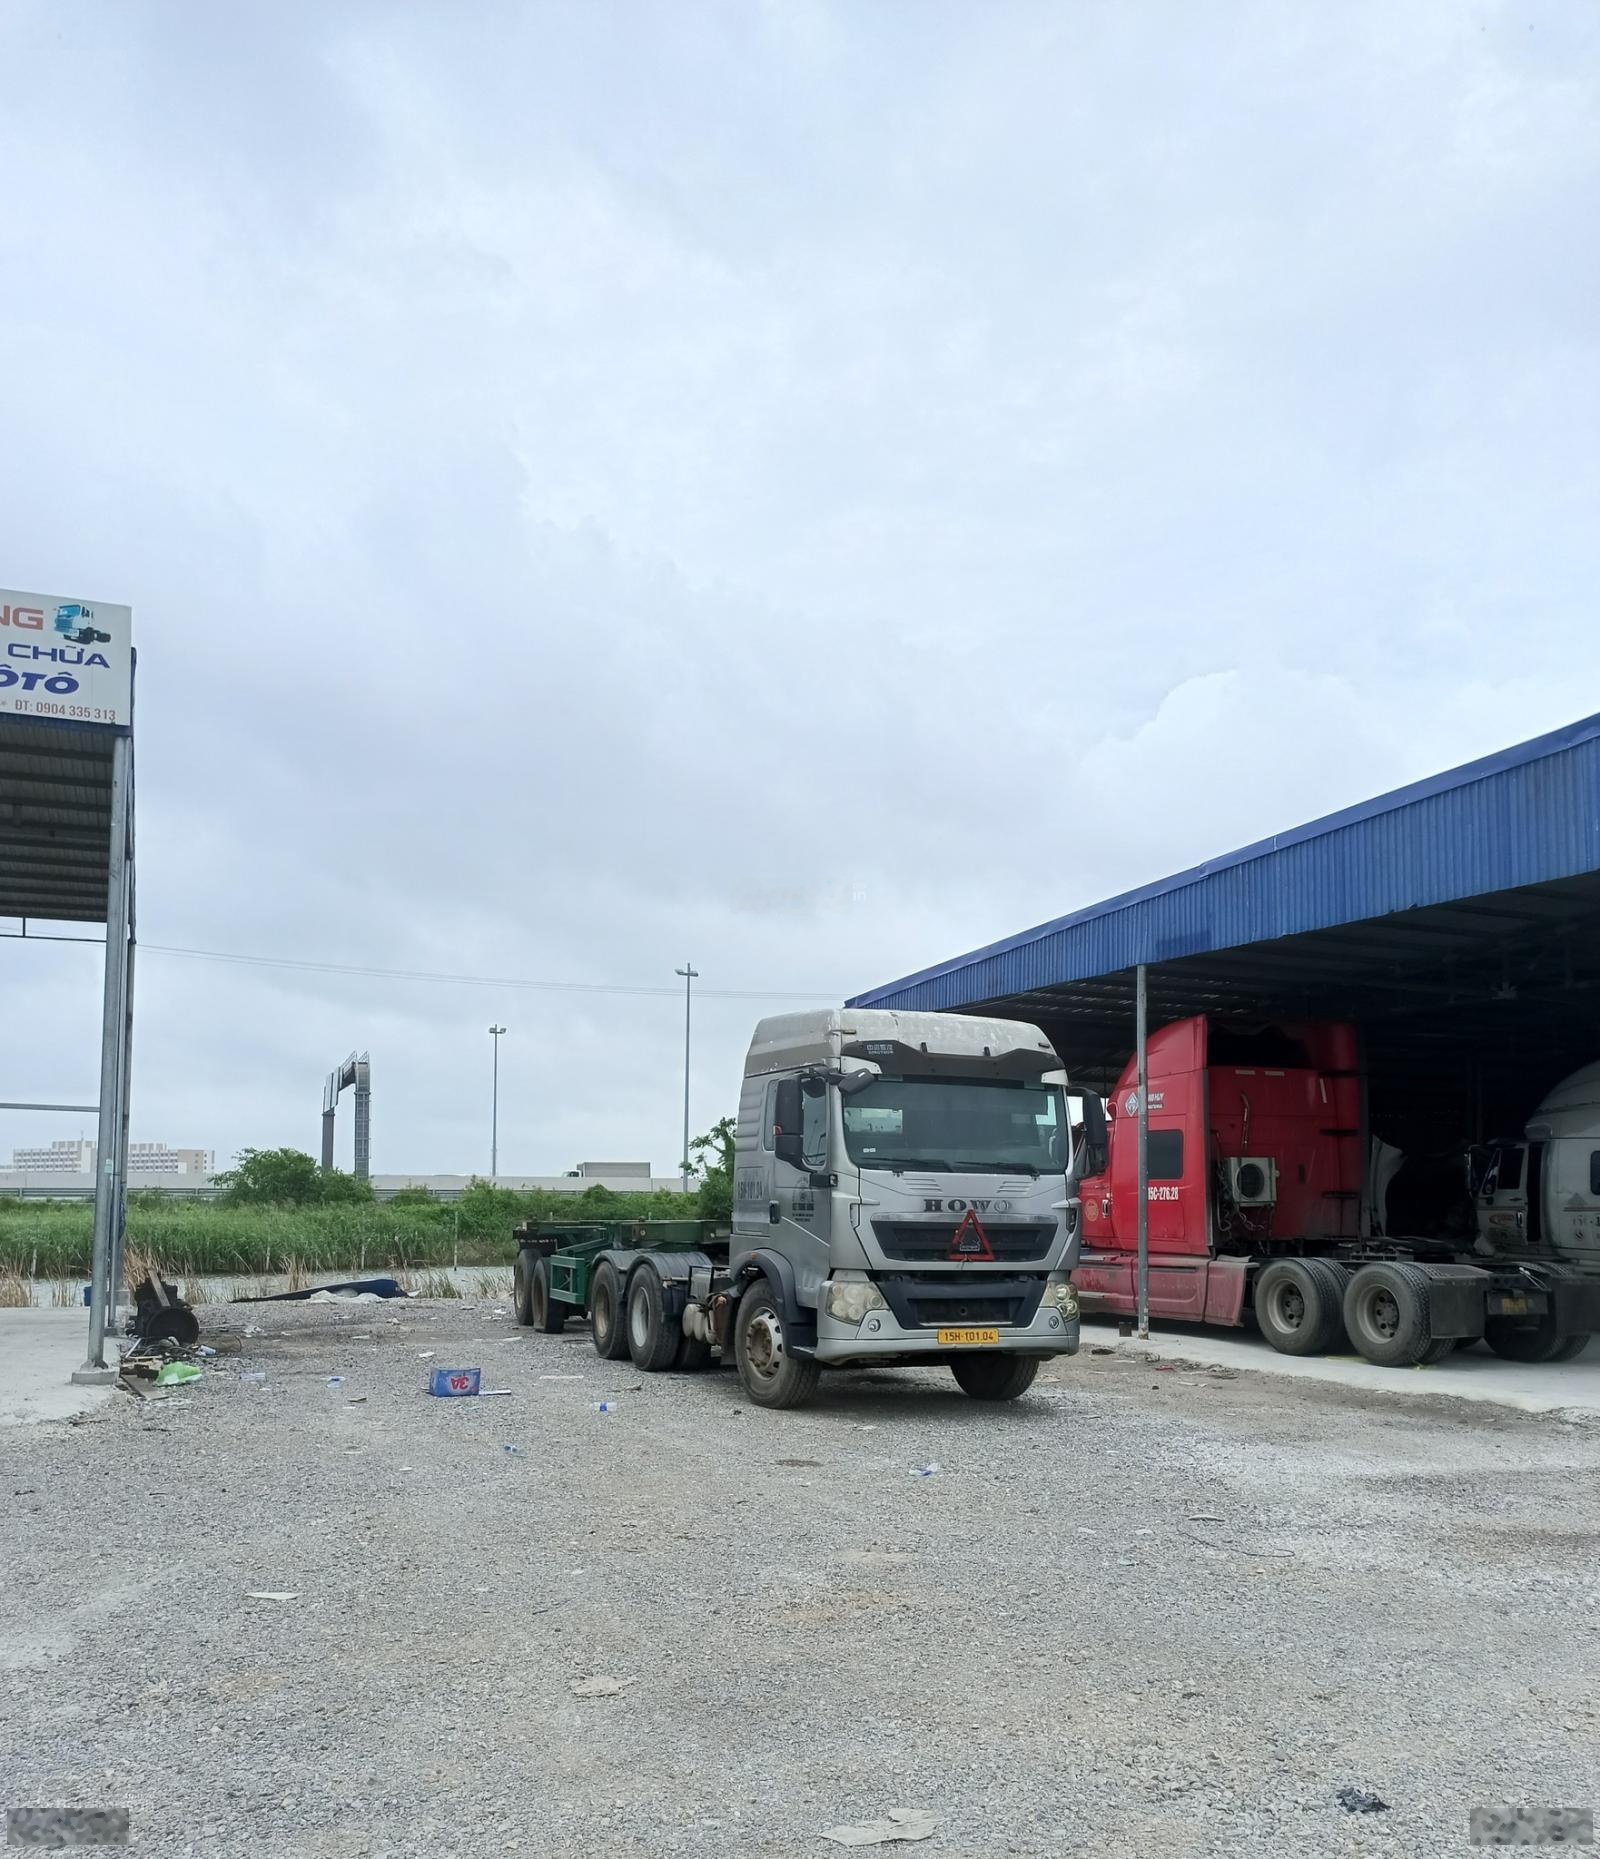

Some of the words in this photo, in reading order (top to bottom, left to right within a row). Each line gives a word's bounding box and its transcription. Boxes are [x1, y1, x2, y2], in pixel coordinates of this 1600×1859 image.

[7, 643, 111, 669] CHỮA
[36, 702, 66, 715] 0904
[69, 705, 91, 718] 335
[94, 708, 116, 721] 313
[923, 1199, 1012, 1213] HOWO
[944, 1331, 994, 1342] 15H-101.04
